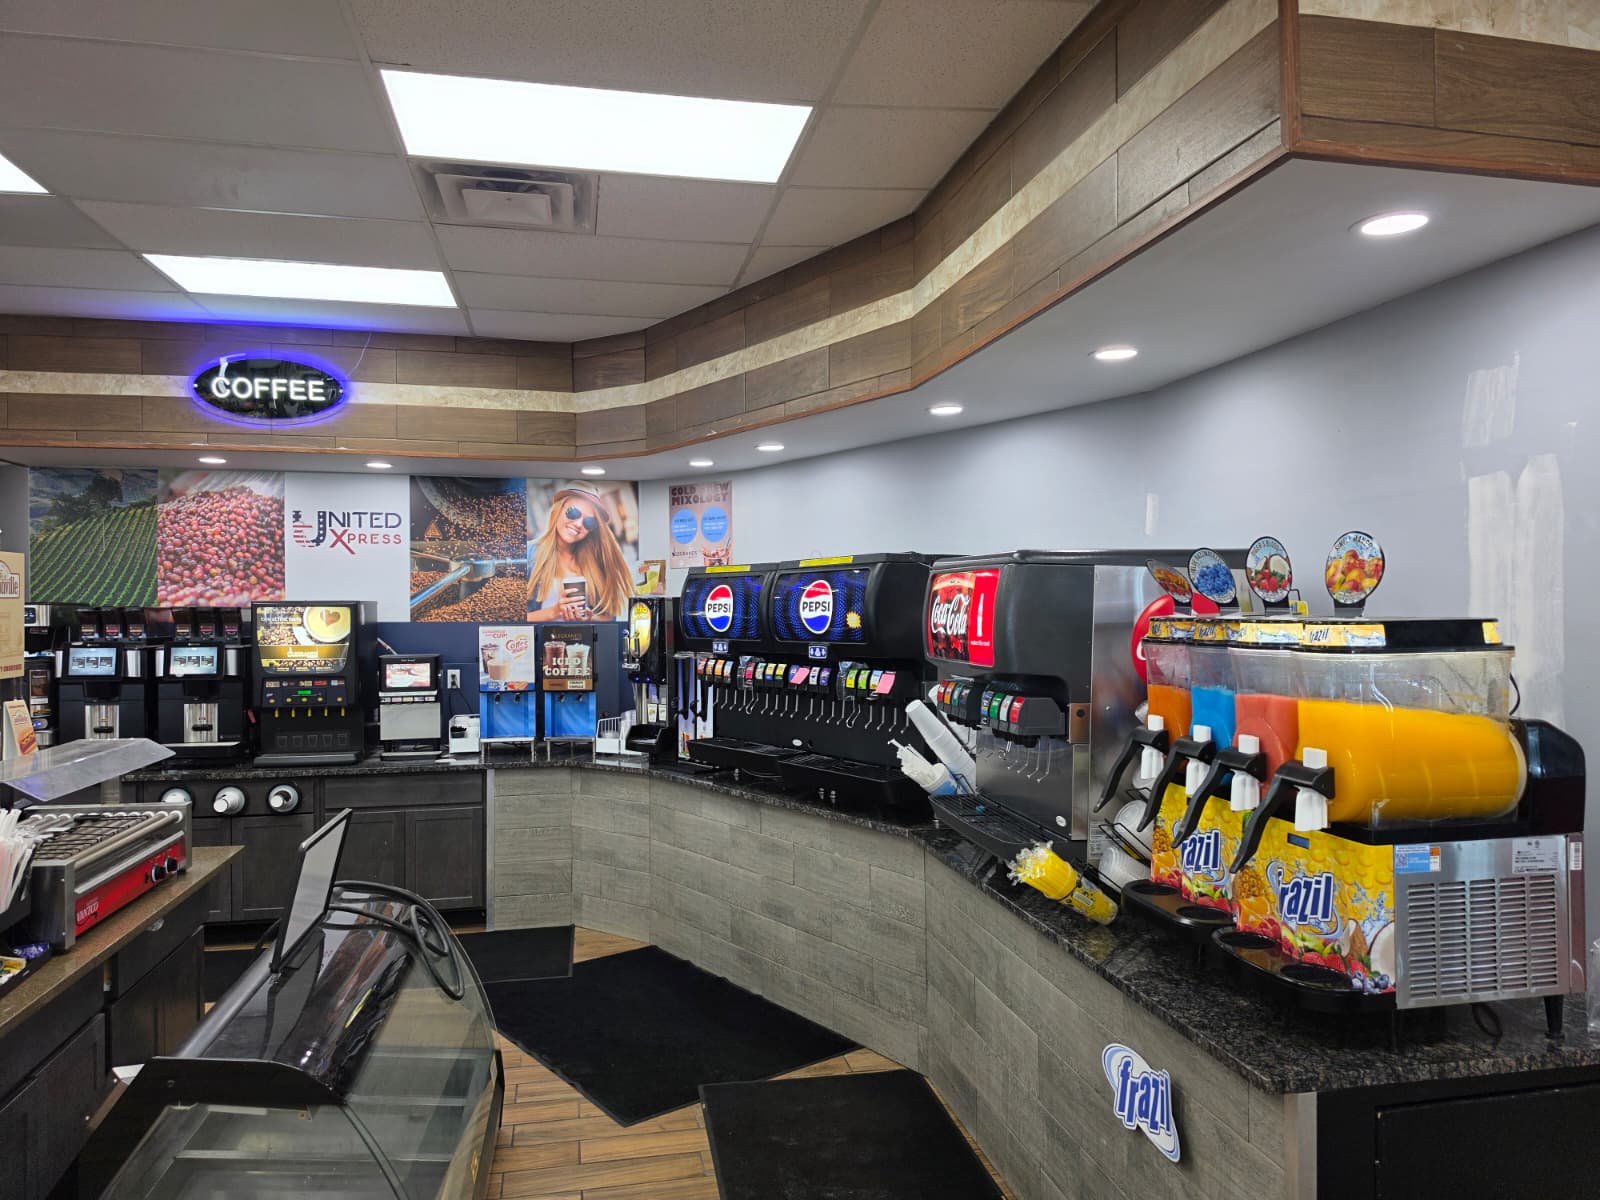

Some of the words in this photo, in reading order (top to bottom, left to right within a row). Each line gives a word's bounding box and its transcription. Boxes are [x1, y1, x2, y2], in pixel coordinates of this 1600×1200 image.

[211, 376, 326, 402] COFFEE
[671, 486, 697, 497] COLD
[671, 492, 729, 506] MIXOLOGY
[329, 528, 402, 555] XPRESS
[707, 602, 731, 614] PEPSI
[802, 601, 830, 613] PEPSI
[544, 667, 591, 676] COFFEE
[1179, 830, 1221, 874] razil
[1116, 1057, 1171, 1134] frazil
